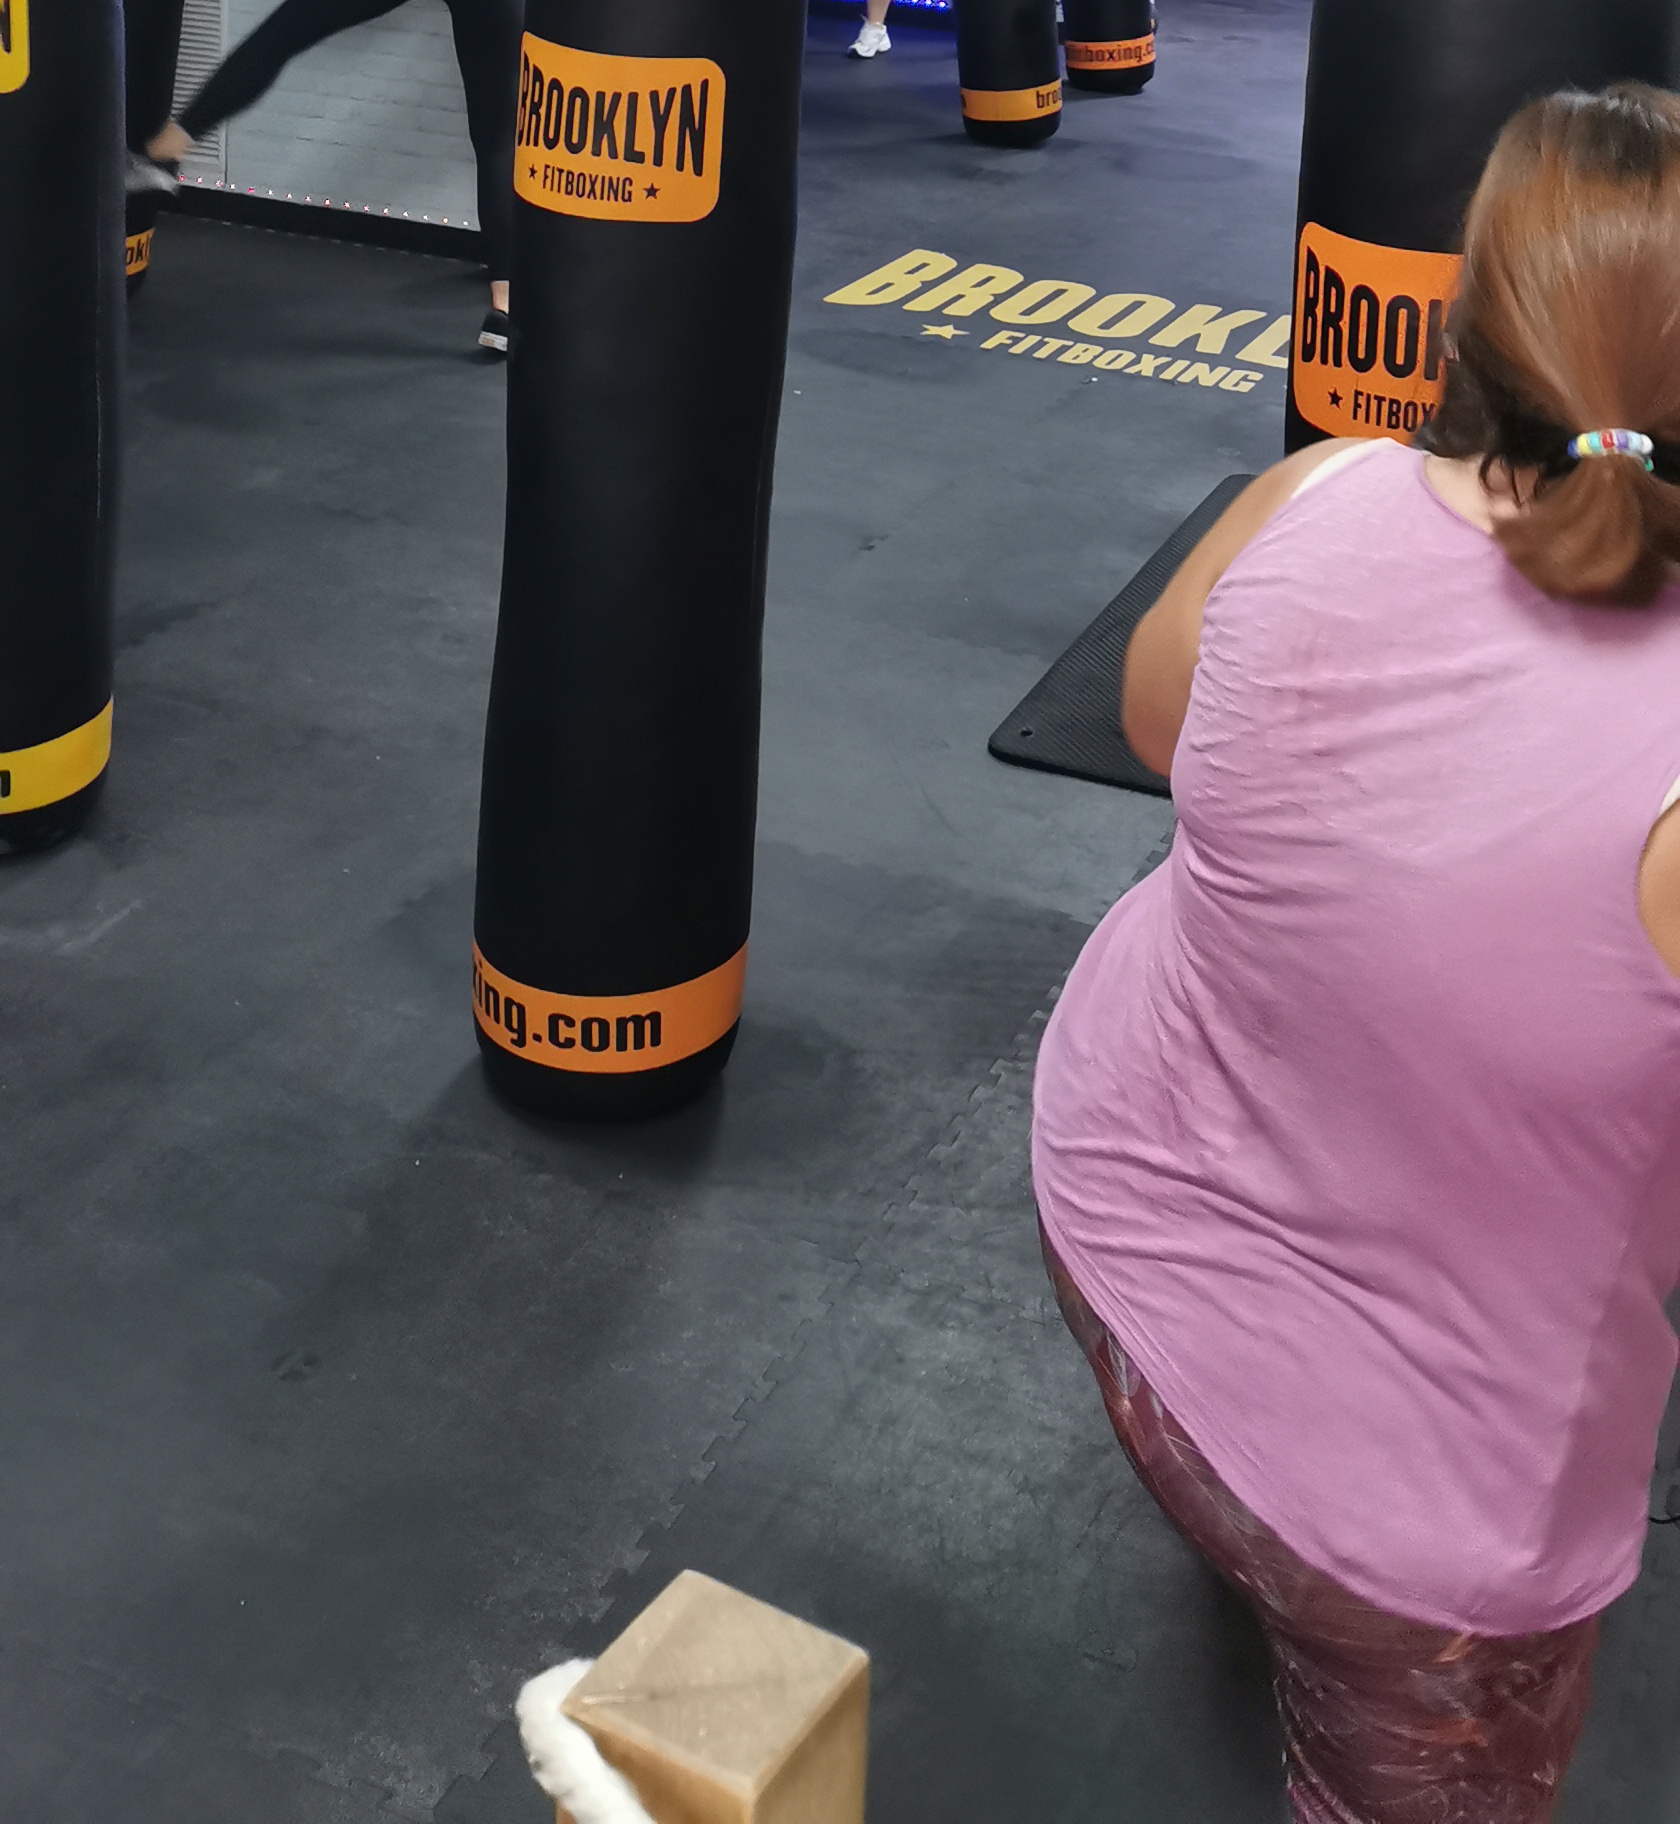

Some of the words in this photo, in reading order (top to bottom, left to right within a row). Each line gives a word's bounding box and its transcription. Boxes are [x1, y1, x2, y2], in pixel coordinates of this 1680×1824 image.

[517, 50, 709, 177] BROOKLYN
[542, 164, 634, 203] FITBOXING
[980, 330, 1264, 393] FITBOXING
